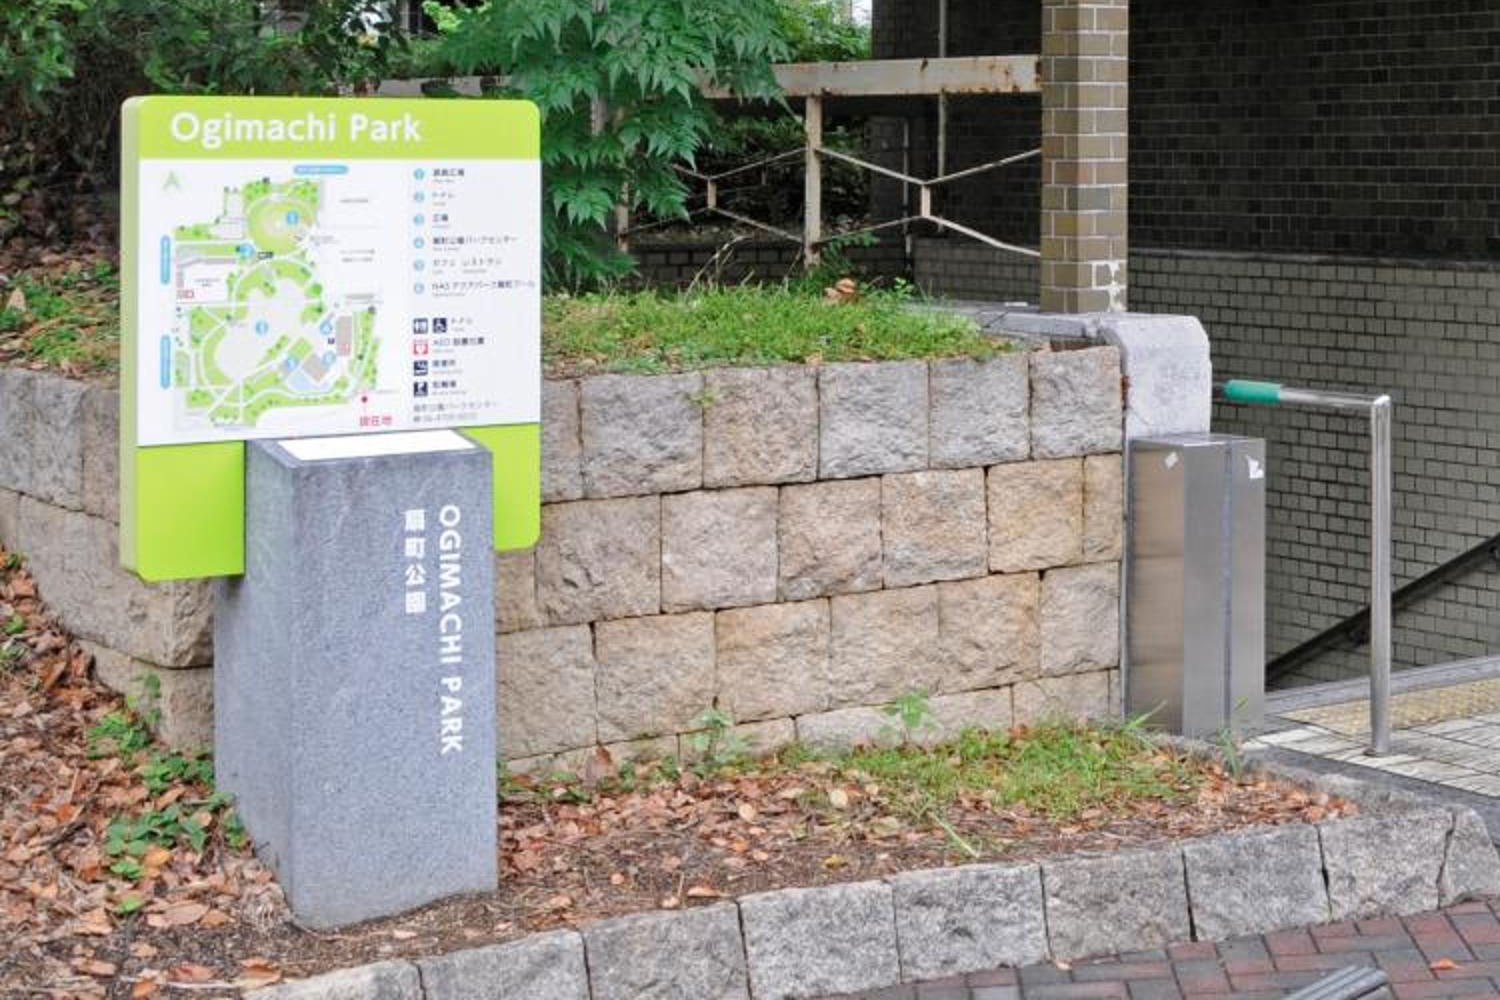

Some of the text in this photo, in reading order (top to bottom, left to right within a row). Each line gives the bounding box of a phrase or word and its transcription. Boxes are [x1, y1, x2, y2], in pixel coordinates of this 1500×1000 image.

[170, 112, 423, 150] Ogimachi Park
[438, 504, 464, 755] OGIMACHI PARK
